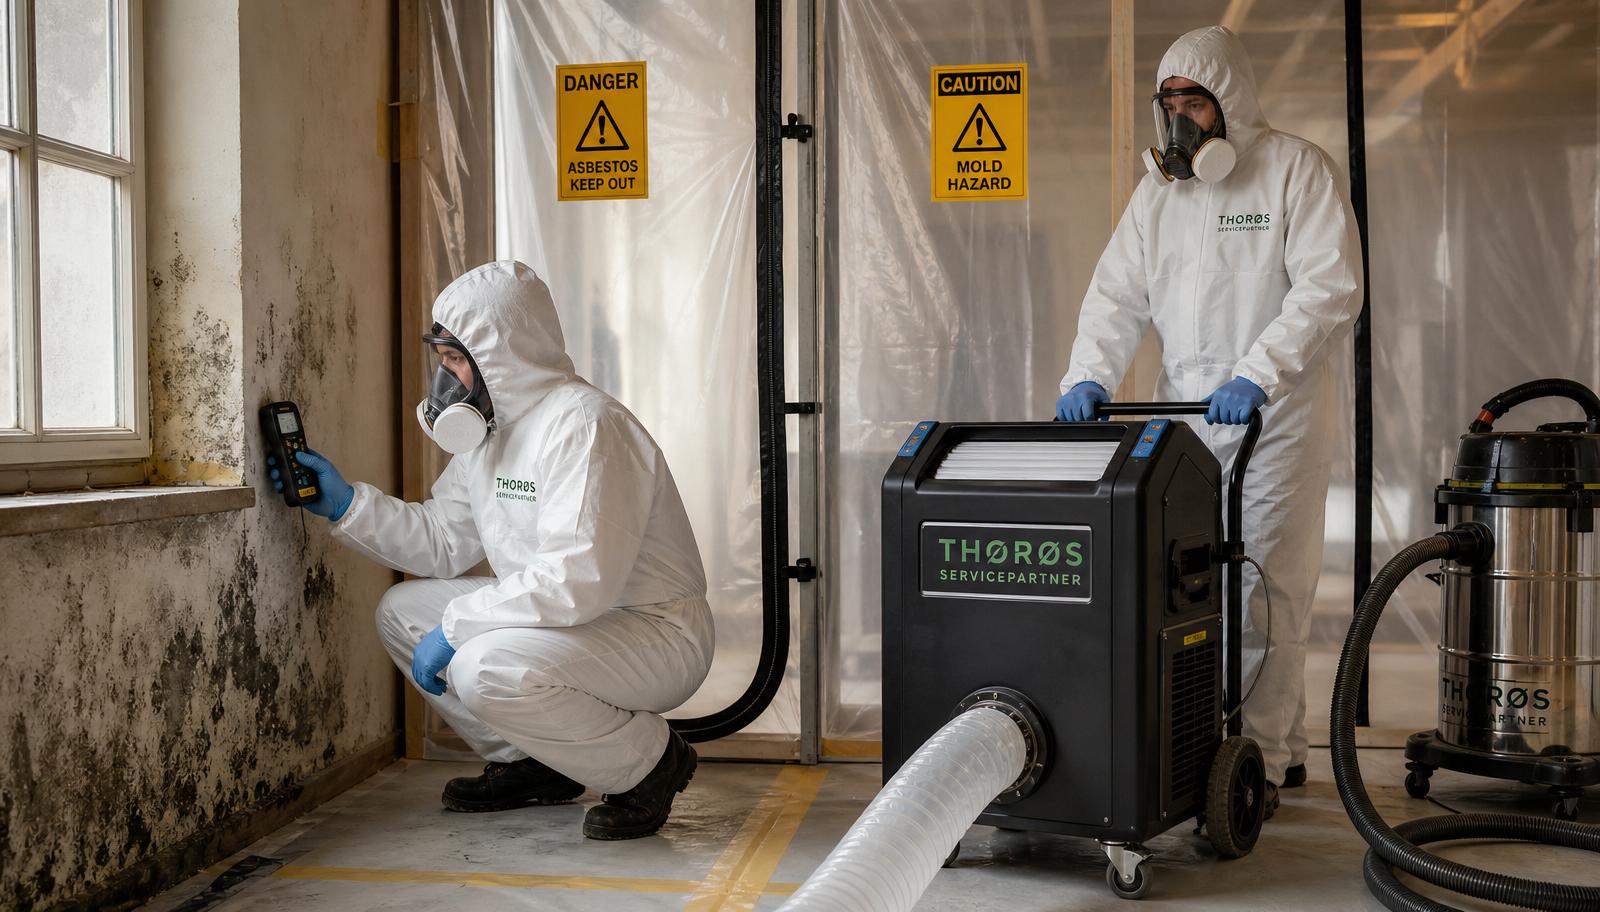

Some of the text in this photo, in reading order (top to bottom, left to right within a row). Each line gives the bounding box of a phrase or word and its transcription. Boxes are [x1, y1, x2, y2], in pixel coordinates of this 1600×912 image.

[564, 72, 639, 92] DANGER
[940, 74, 1018, 93] CAUTION
[567, 159, 639, 174] ASBESTOS
[957, 160, 1003, 173] MOLD
[570, 177, 636, 191] KEEP OUT
[948, 177, 1012, 191] HAZARD
[1218, 213, 1270, 225] THORØS
[938, 538, 1083, 567] THØRØS
[940, 569, 1081, 586] SERVICEPARTNER
[1442, 703, 1547, 727] SERVICARTNER
